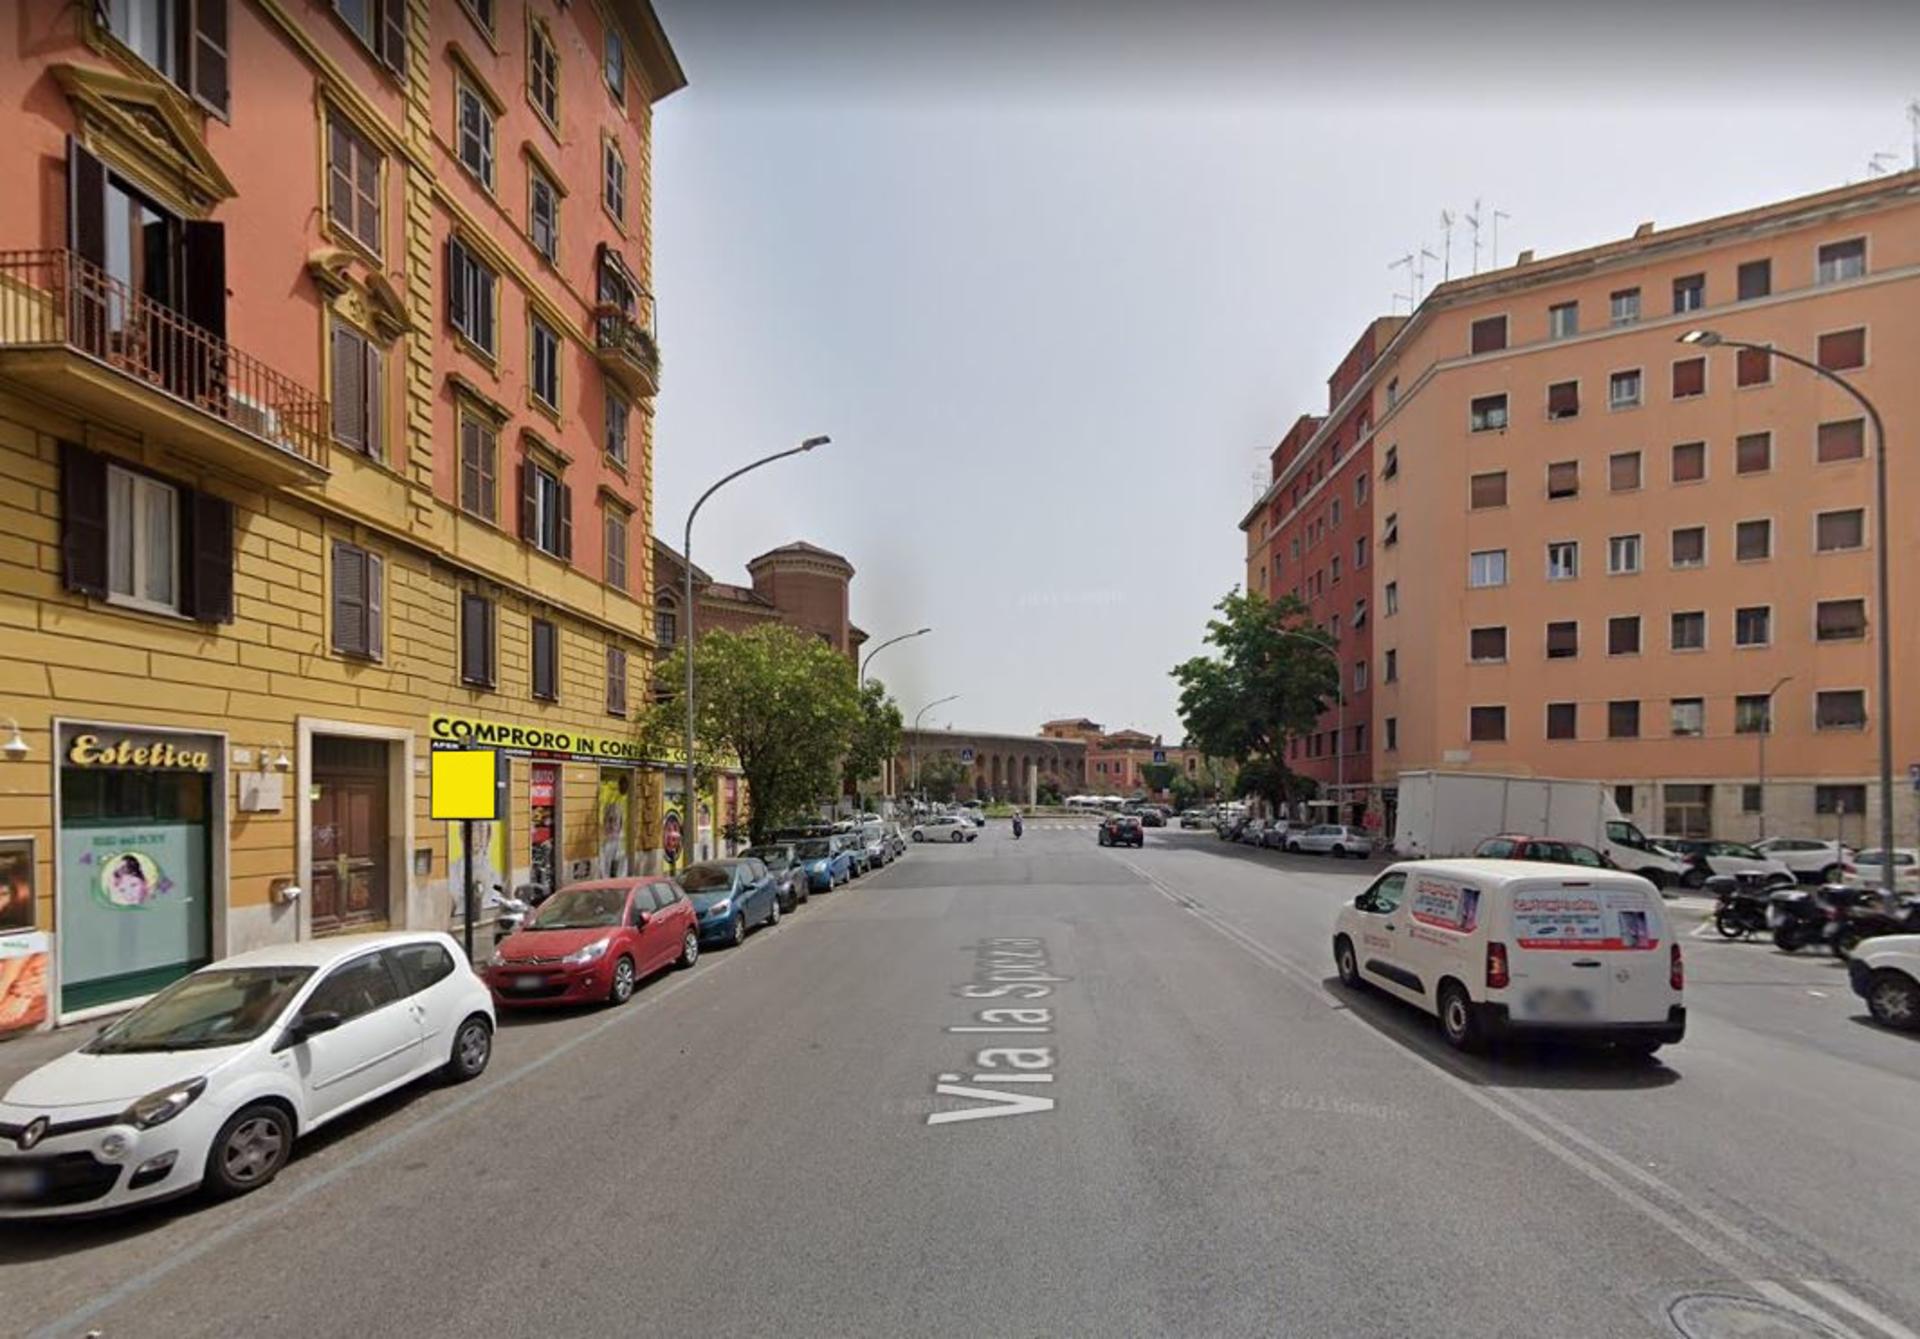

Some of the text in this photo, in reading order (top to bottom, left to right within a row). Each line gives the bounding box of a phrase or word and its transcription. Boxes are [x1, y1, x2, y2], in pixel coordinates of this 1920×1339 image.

[69, 733, 210, 771] Estetica
[432, 718, 570, 750] COMPRORO
[576, 737, 595, 753] IN
